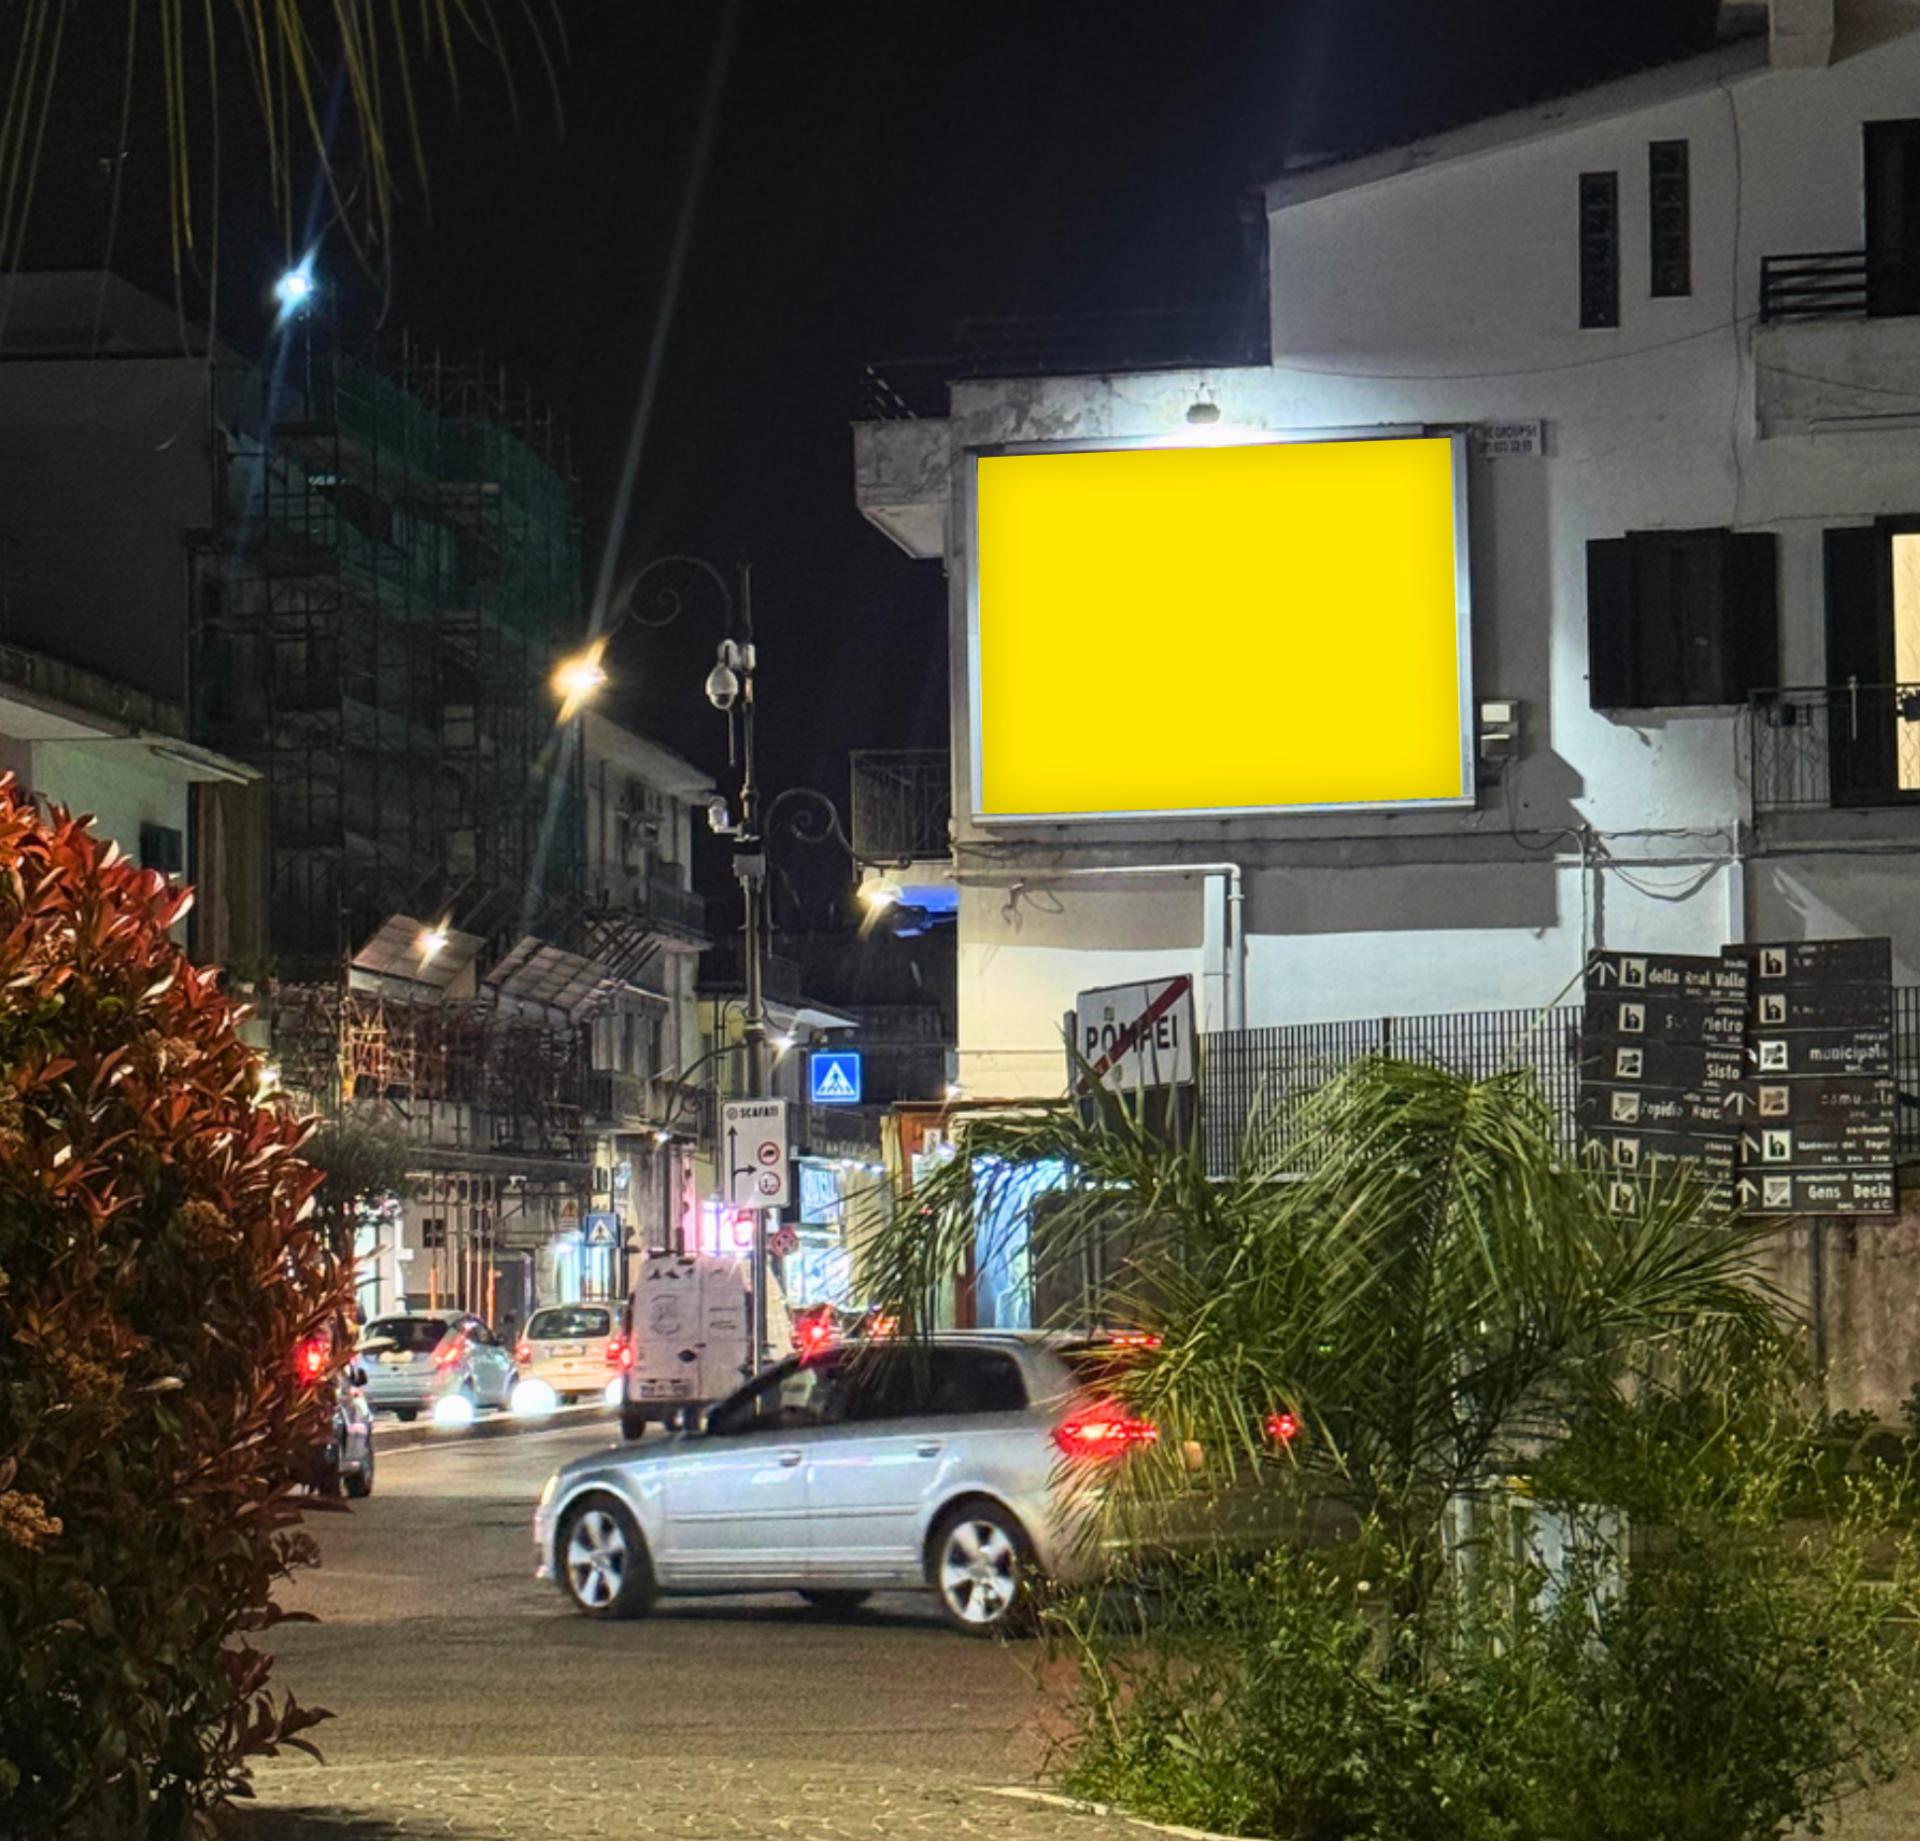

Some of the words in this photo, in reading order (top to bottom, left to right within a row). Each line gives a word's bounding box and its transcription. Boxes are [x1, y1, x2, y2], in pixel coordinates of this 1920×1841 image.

[1648, 968, 1680, 984] della
[1715, 972, 1746, 988] Valle
[1086, 1014, 1178, 1060] POMPEI
[1706, 1063, 1740, 1080] Sisto
[739, 1105, 779, 1120] SCAFATI
[1808, 1184, 1841, 1199] Gens
[1853, 1182, 1892, 1199] Decia
